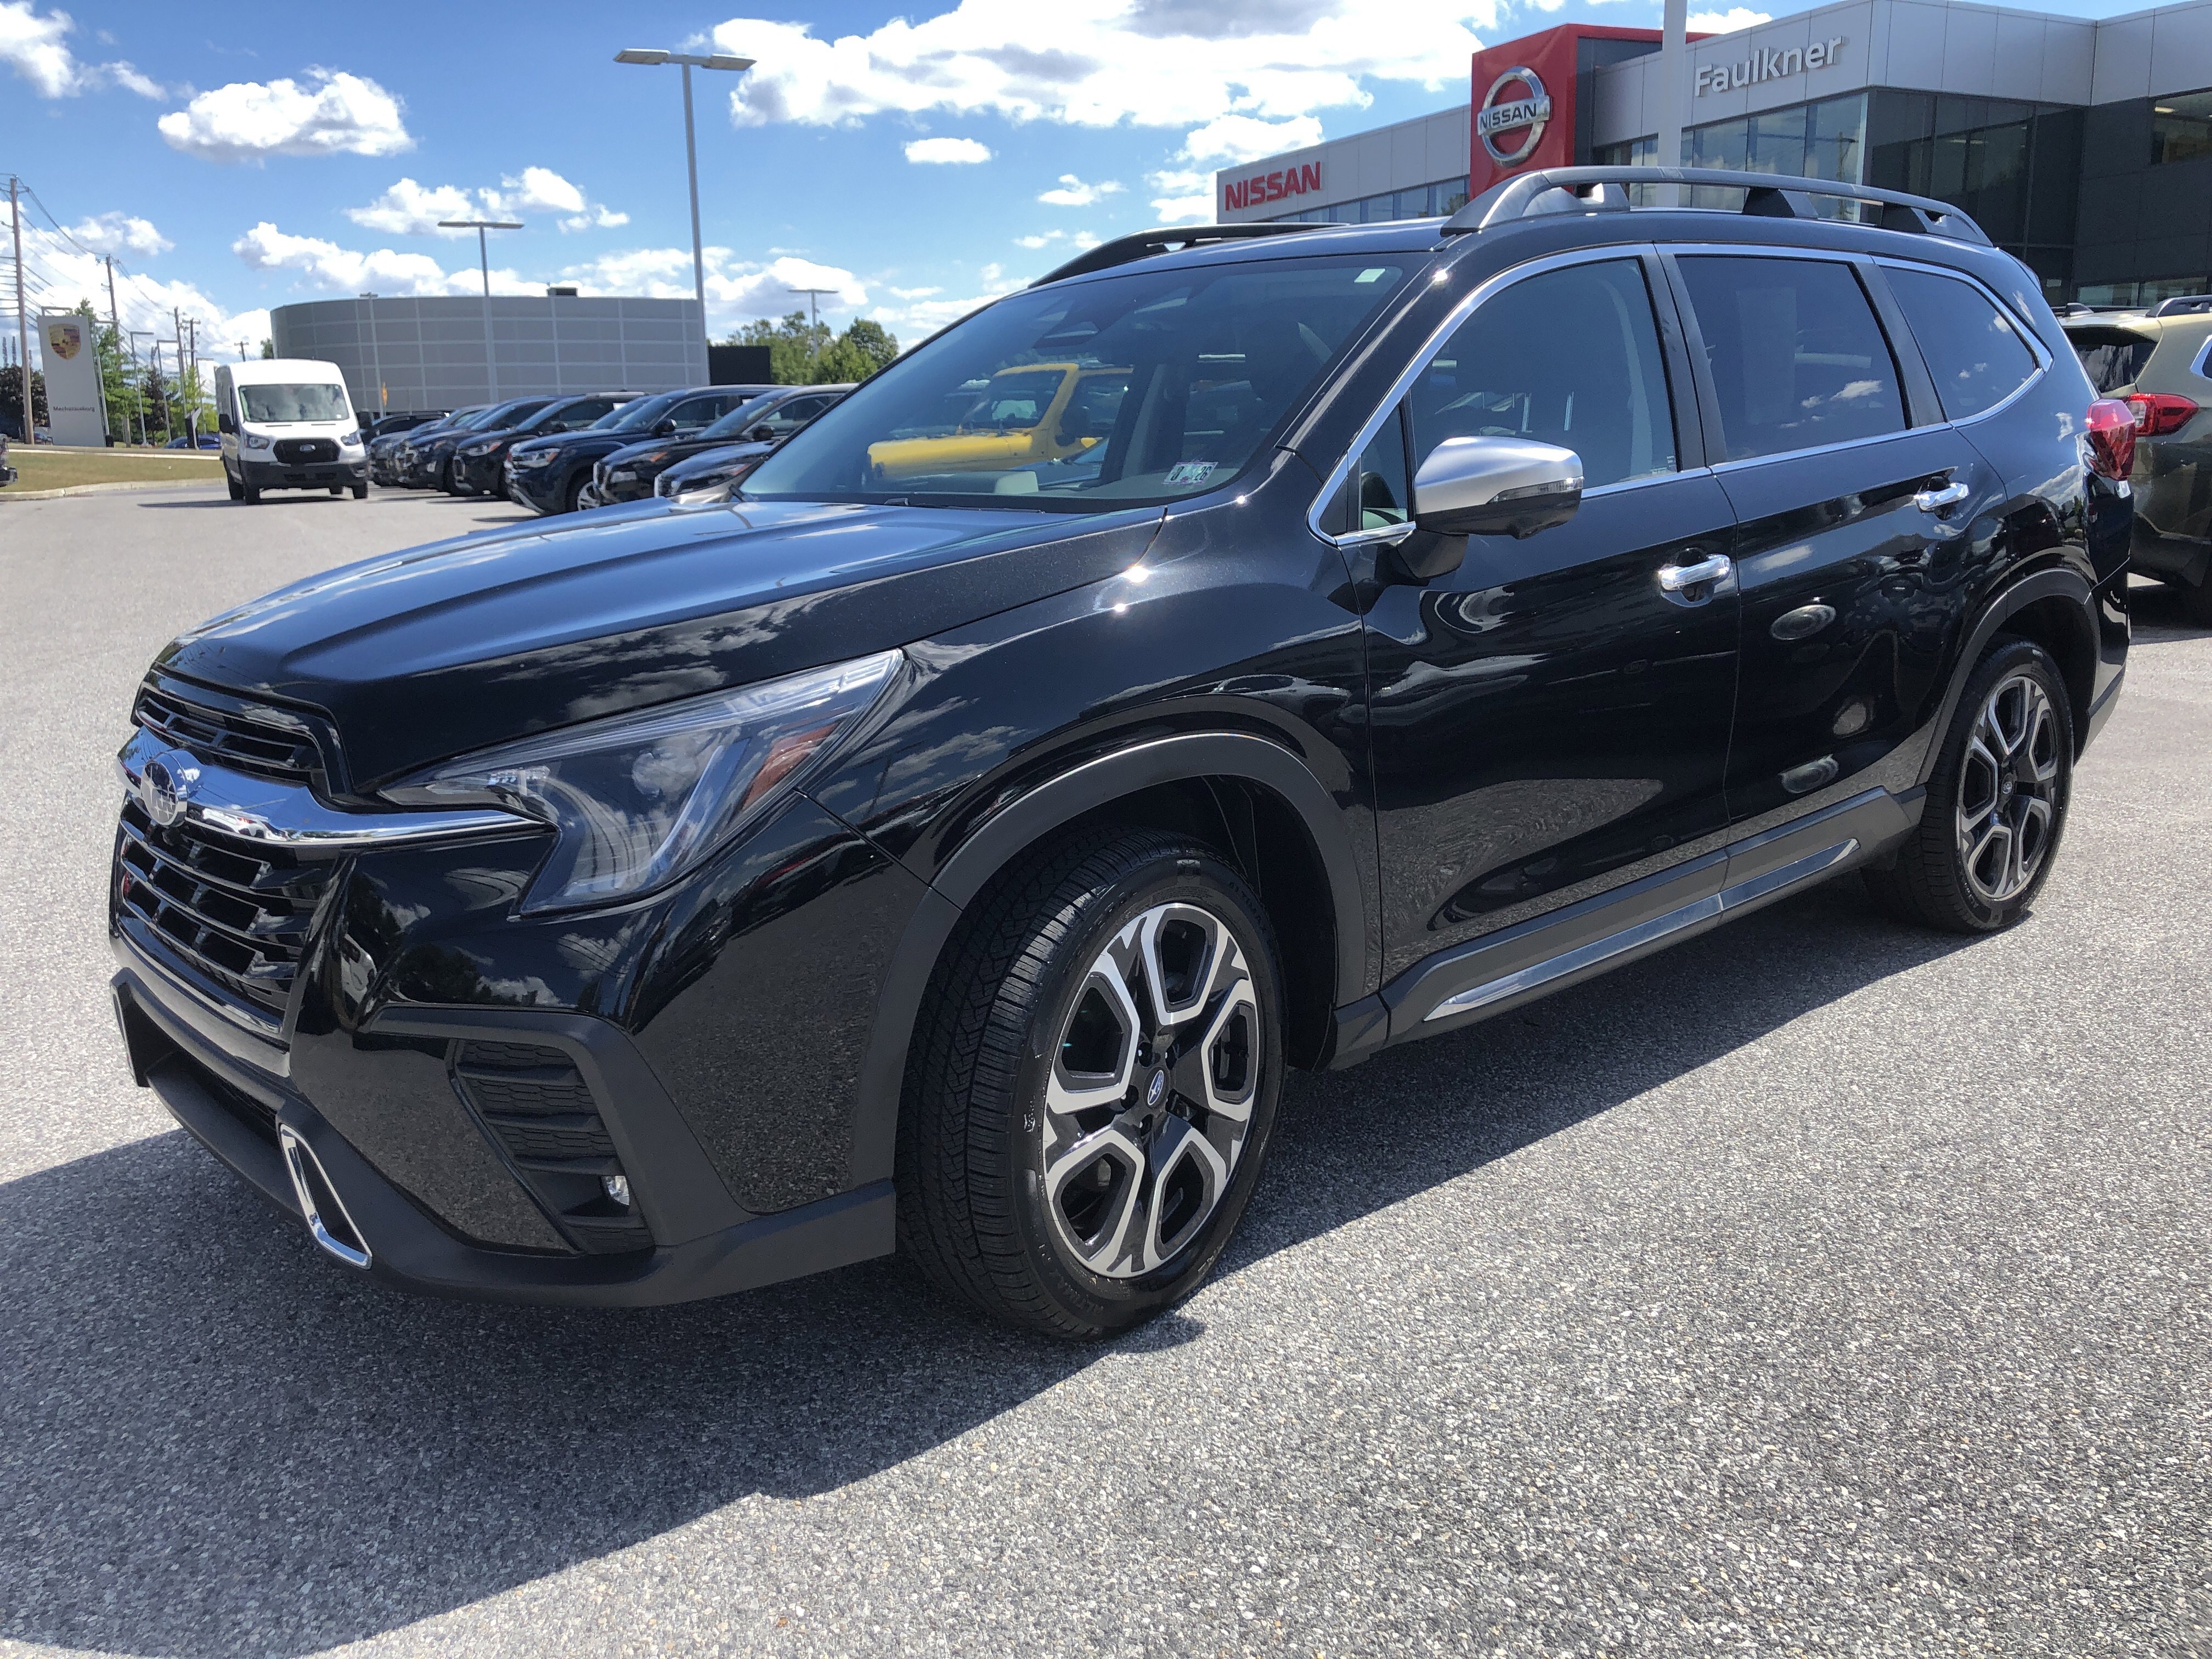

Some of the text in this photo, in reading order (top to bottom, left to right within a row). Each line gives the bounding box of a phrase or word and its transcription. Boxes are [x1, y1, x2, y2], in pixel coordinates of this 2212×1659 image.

[1695, 36, 1843, 97] Faulkner
[1480, 103, 1537, 128] NISSAN
[1225, 161, 1321, 211] NISSAN
[1194, 466, 1212, 481] 26
